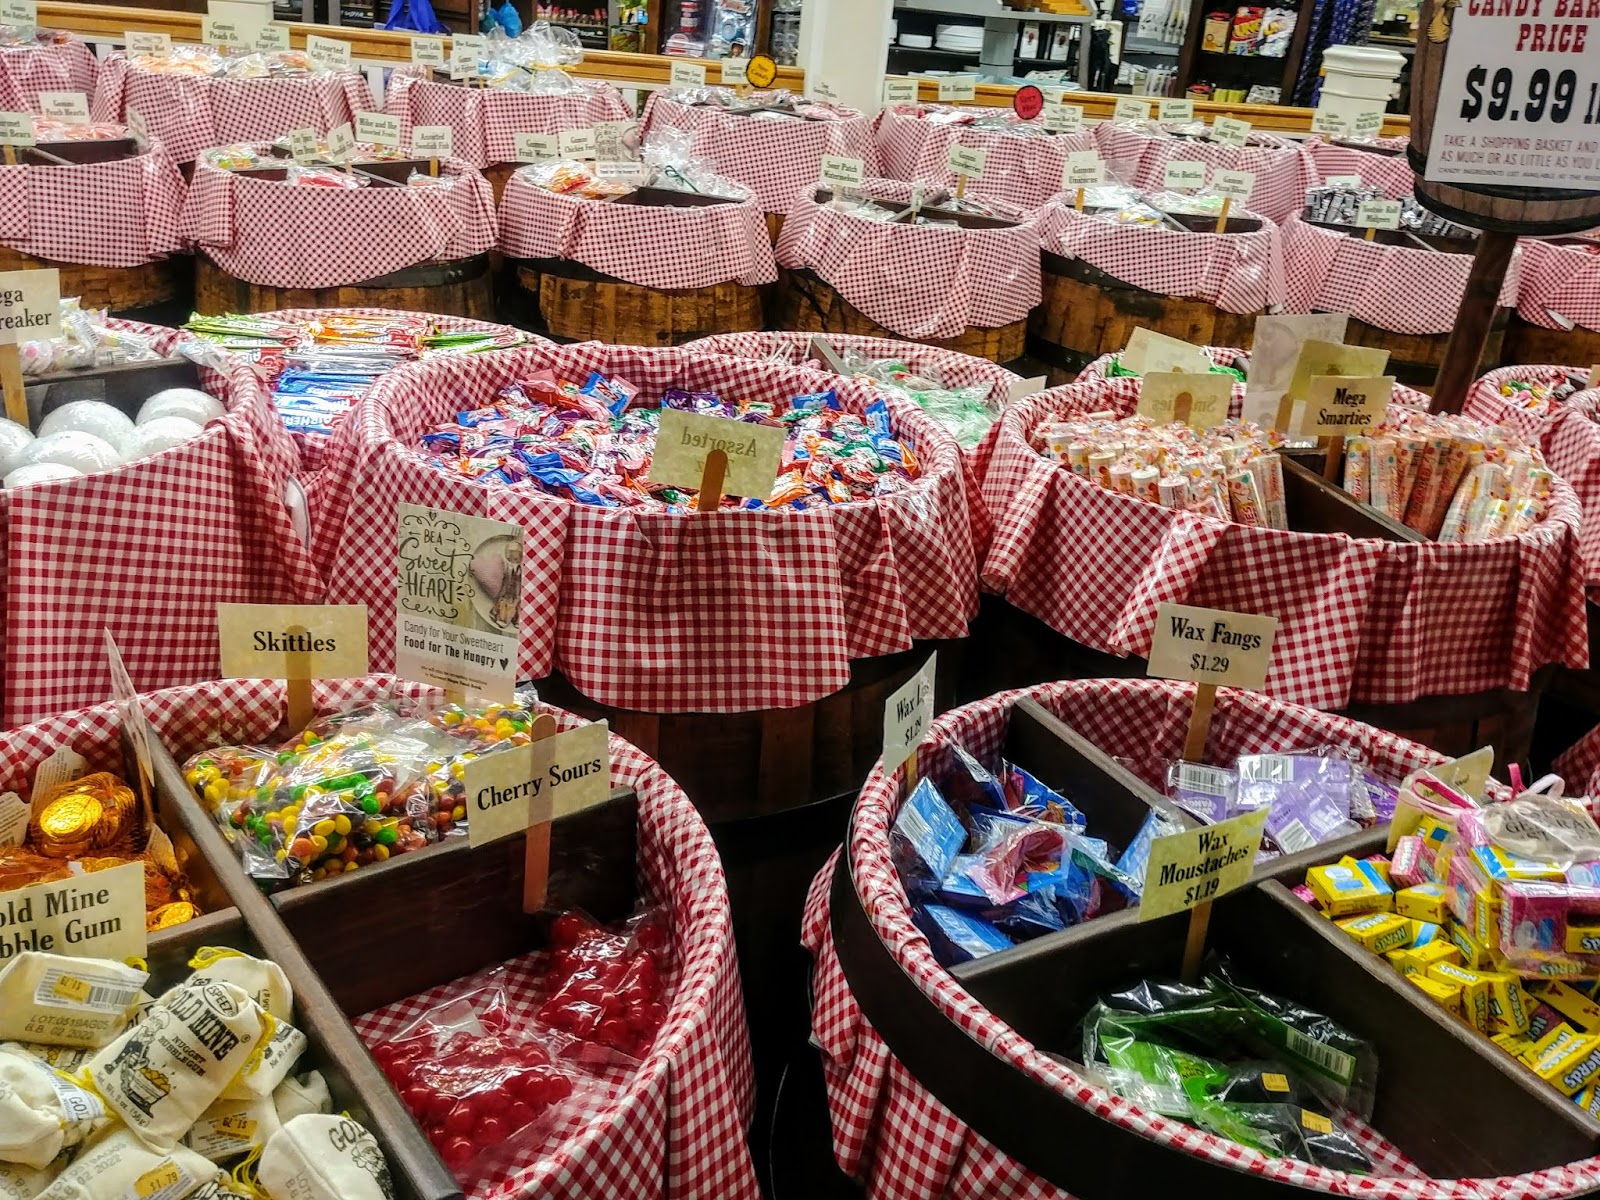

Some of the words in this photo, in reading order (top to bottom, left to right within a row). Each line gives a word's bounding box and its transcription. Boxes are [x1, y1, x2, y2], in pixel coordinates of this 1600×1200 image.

[1468, 0, 1542, 17] CANDY
[1554, 0, 1600, 18] BAR
[1515, 23, 1589, 53] PRICE
[1460, 64, 1577, 123] $9.99
[1443, 134, 1467, 147] TAKE
[1469, 135, 1476, 147] A
[1481, 136, 1530, 151] SHOPPING
[1535, 138, 1573, 152] BASKET
[1576, 141, 1598, 153] AND
[1440, 150, 1453, 162] AS
[1457, 151, 1485, 163] MUCH
[1487, 152, 1501, 164] OR
[1504, 153, 1517, 165] AS
[1520, 153, 1552, 167] LITTLE
[1554, 155, 1568, 168] AS
[1333, 387, 1367, 407] Mega
[1317, 410, 1373, 427] Smarties
[400, 537, 474, 579] Sweet
[405, 571, 455, 605] HEART
[253, 630, 337, 652] Skittles
[404, 620, 428, 638] Candy
[429, 624, 440, 637] for
[441, 628, 458, 643] Your
[459, 632, 504, 654] Sweetheart
[1170, 616, 1205, 642] Wax
[1211, 622, 1262, 651] Fangs
[403, 635, 425, 650] Food
[428, 640, 441, 654] for
[444, 644, 460, 659] The
[463, 647, 495, 669] Hungry
[1190, 653, 1229, 673] $1.29
[896, 700, 916, 723] Wax
[477, 777, 543, 811] Cherry
[549, 758, 602, 787] Sours
[1198, 830, 1229, 855] Wax
[1158, 845, 1250, 887] Moustaches
[45, 888, 109, 918] Mine
[1184, 877, 1220, 906] $1.19
[65, 917, 122, 944] Gum
[206, 984, 234, 1014] ESPEEZ
[187, 1007, 240, 1062] MINE
[171, 1035, 207, 1065] NUGGET
[150, 1171, 178, 1192] $1.79
